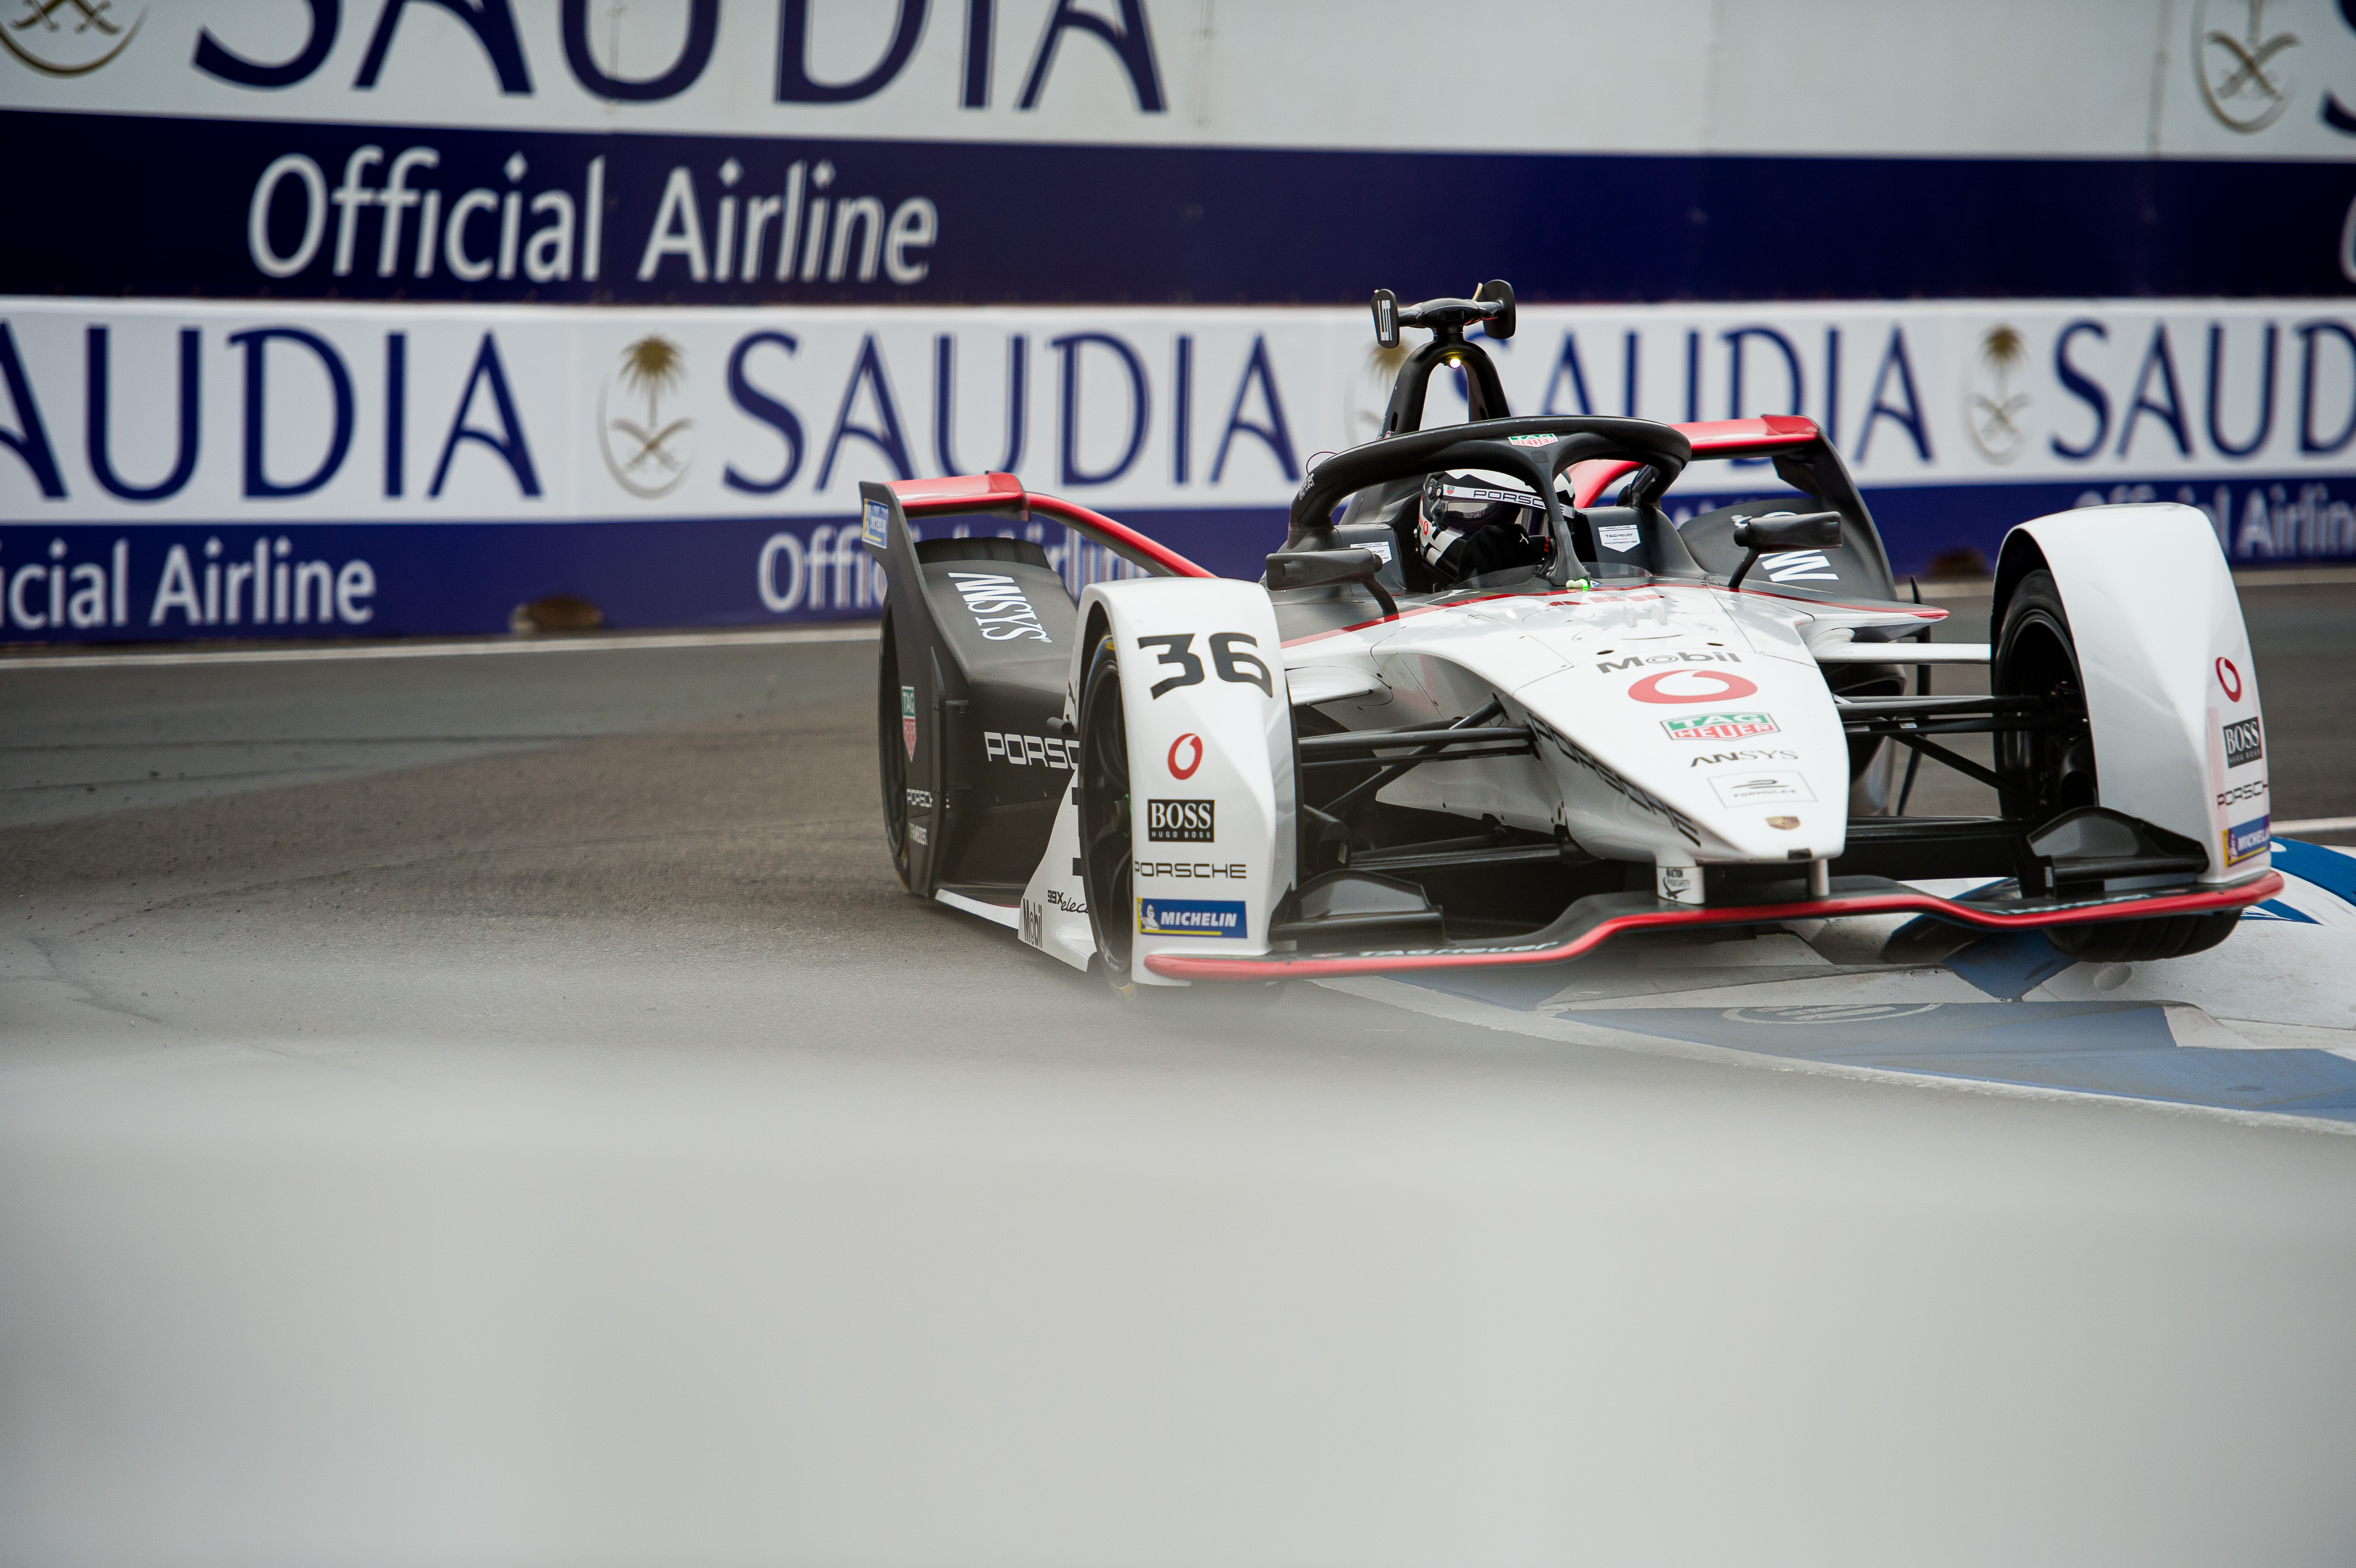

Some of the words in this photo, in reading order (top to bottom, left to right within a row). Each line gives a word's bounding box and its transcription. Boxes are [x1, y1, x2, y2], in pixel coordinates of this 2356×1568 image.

[248, 144, 604, 282] Official
[638, 156, 938, 284] Airline
[722, 328, 1299, 494] SAUDIA
[149, 537, 376, 625] Airline
[948, 572, 1049, 641] ANSYS
[1137, 632, 1273, 700] 36
[1596, 652, 1742, 673] Mobil
[1673, 714, 1764, 727] TAG
[1675, 723, 1774, 739] HEUER
[2225, 721, 2260, 754] BOSS
[1691, 750, 1799, 767] ANSYS
[1151, 803, 1211, 828] BOSS
[1023, 898, 1043, 949] Mobil
[1160, 911, 1237, 927] MICHELIN
